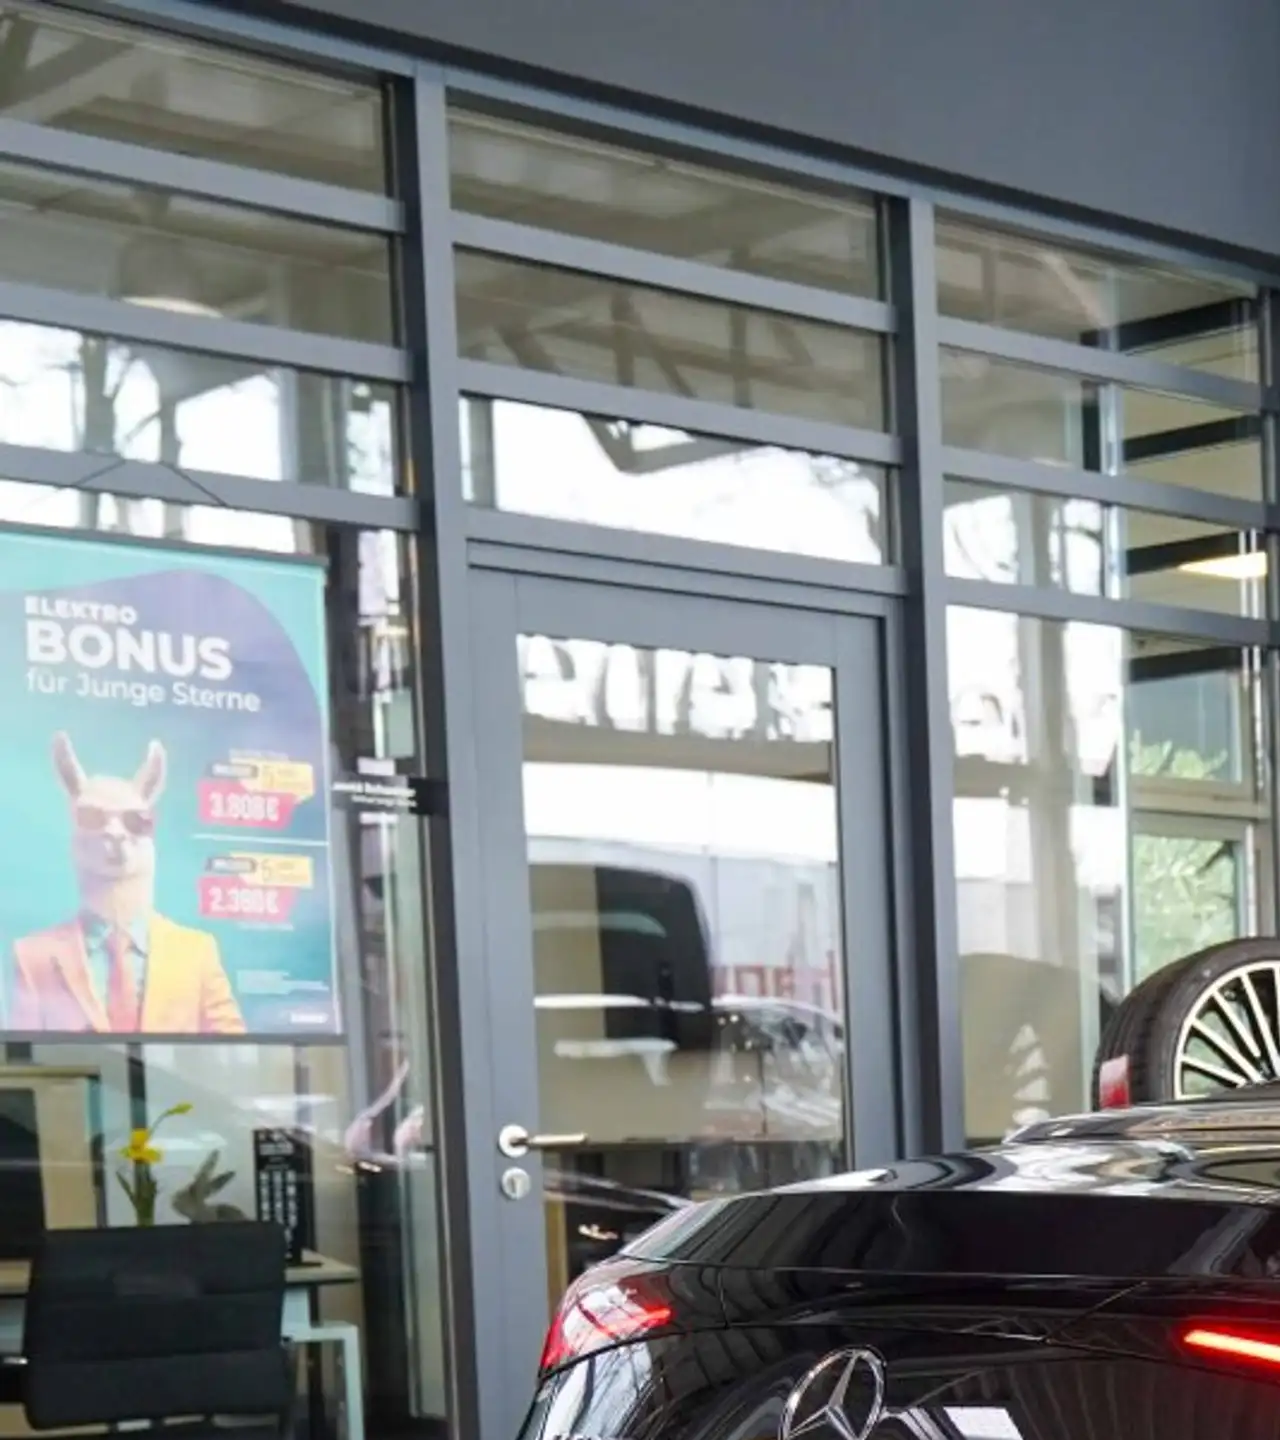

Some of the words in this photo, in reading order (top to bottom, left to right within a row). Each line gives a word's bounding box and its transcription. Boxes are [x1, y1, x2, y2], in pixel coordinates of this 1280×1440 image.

[24, 596, 138, 625] ELEKTRO
[26, 618, 233, 681] BONUS
[26, 666, 69, 694] für
[76, 672, 166, 707] Junge
[172, 681, 261, 712] Sterne
